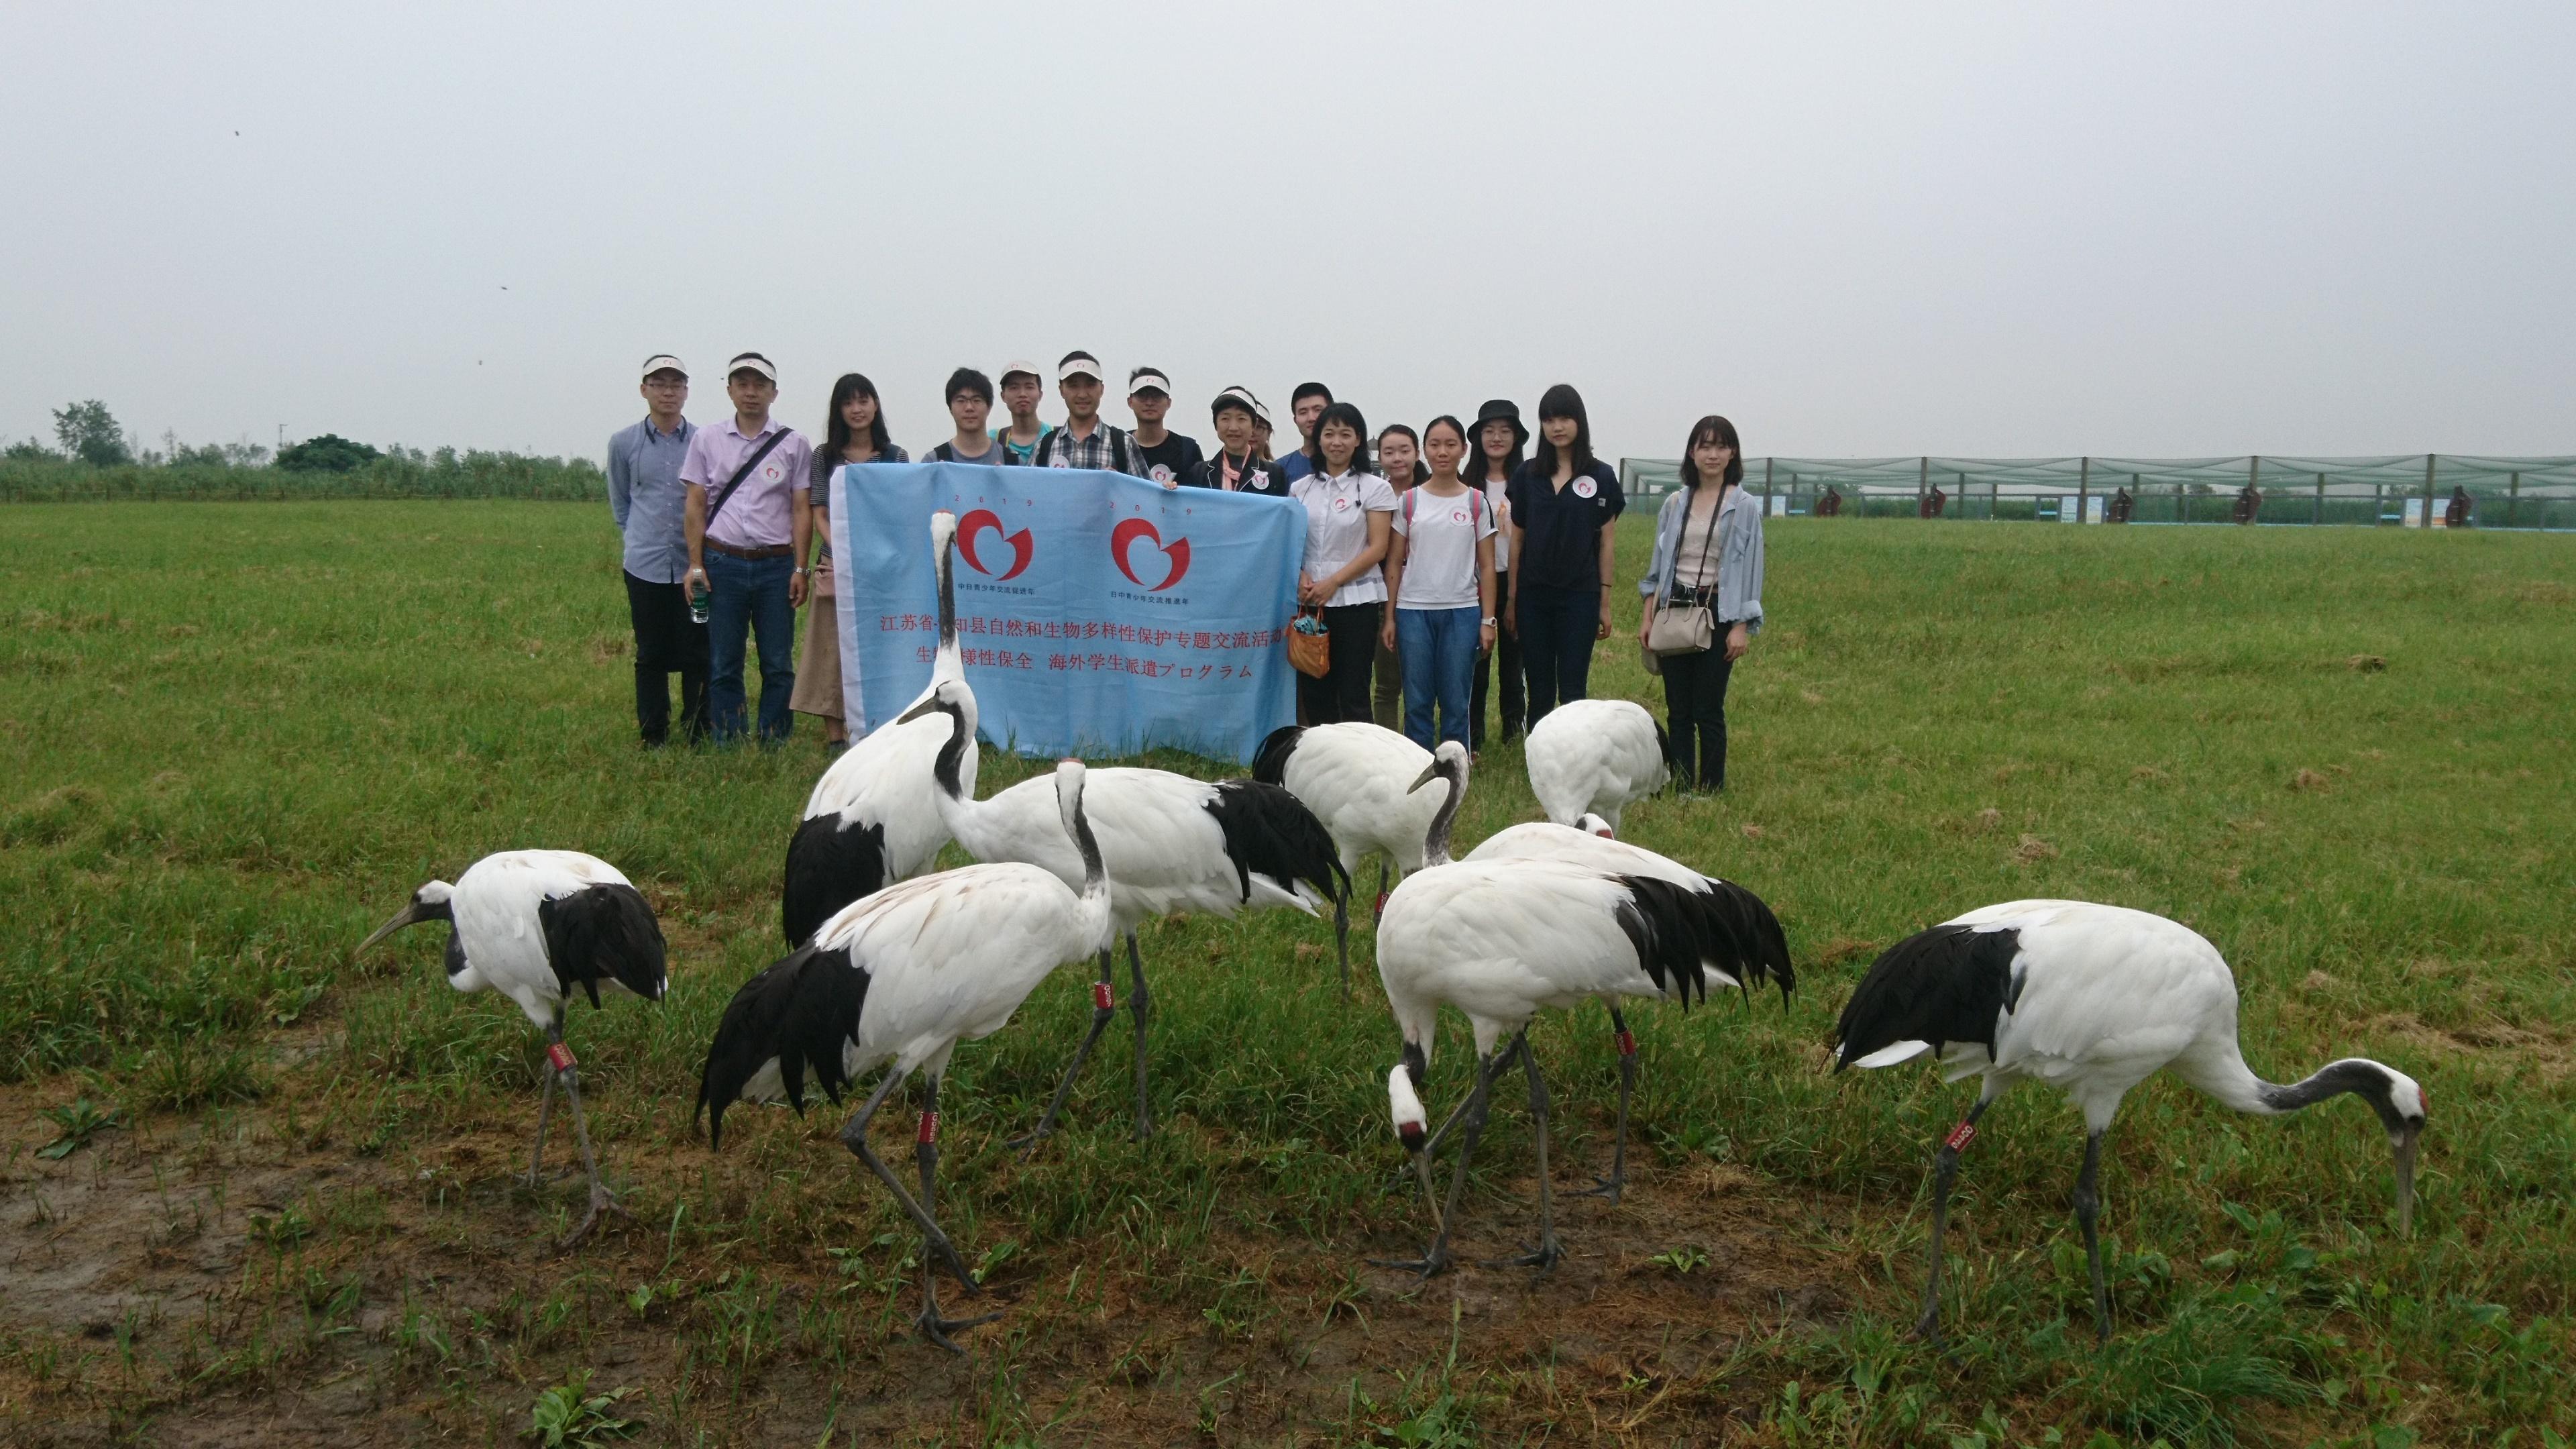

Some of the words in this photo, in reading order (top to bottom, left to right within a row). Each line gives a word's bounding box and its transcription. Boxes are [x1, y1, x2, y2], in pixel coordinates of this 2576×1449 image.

[955, 494, 1032, 506] 2019
[1110, 502, 1191, 515] 2019
[915, 645, 1033, 669] 生様性保全
[1048, 653, 1252, 680] 海外学生派遣プログラム
